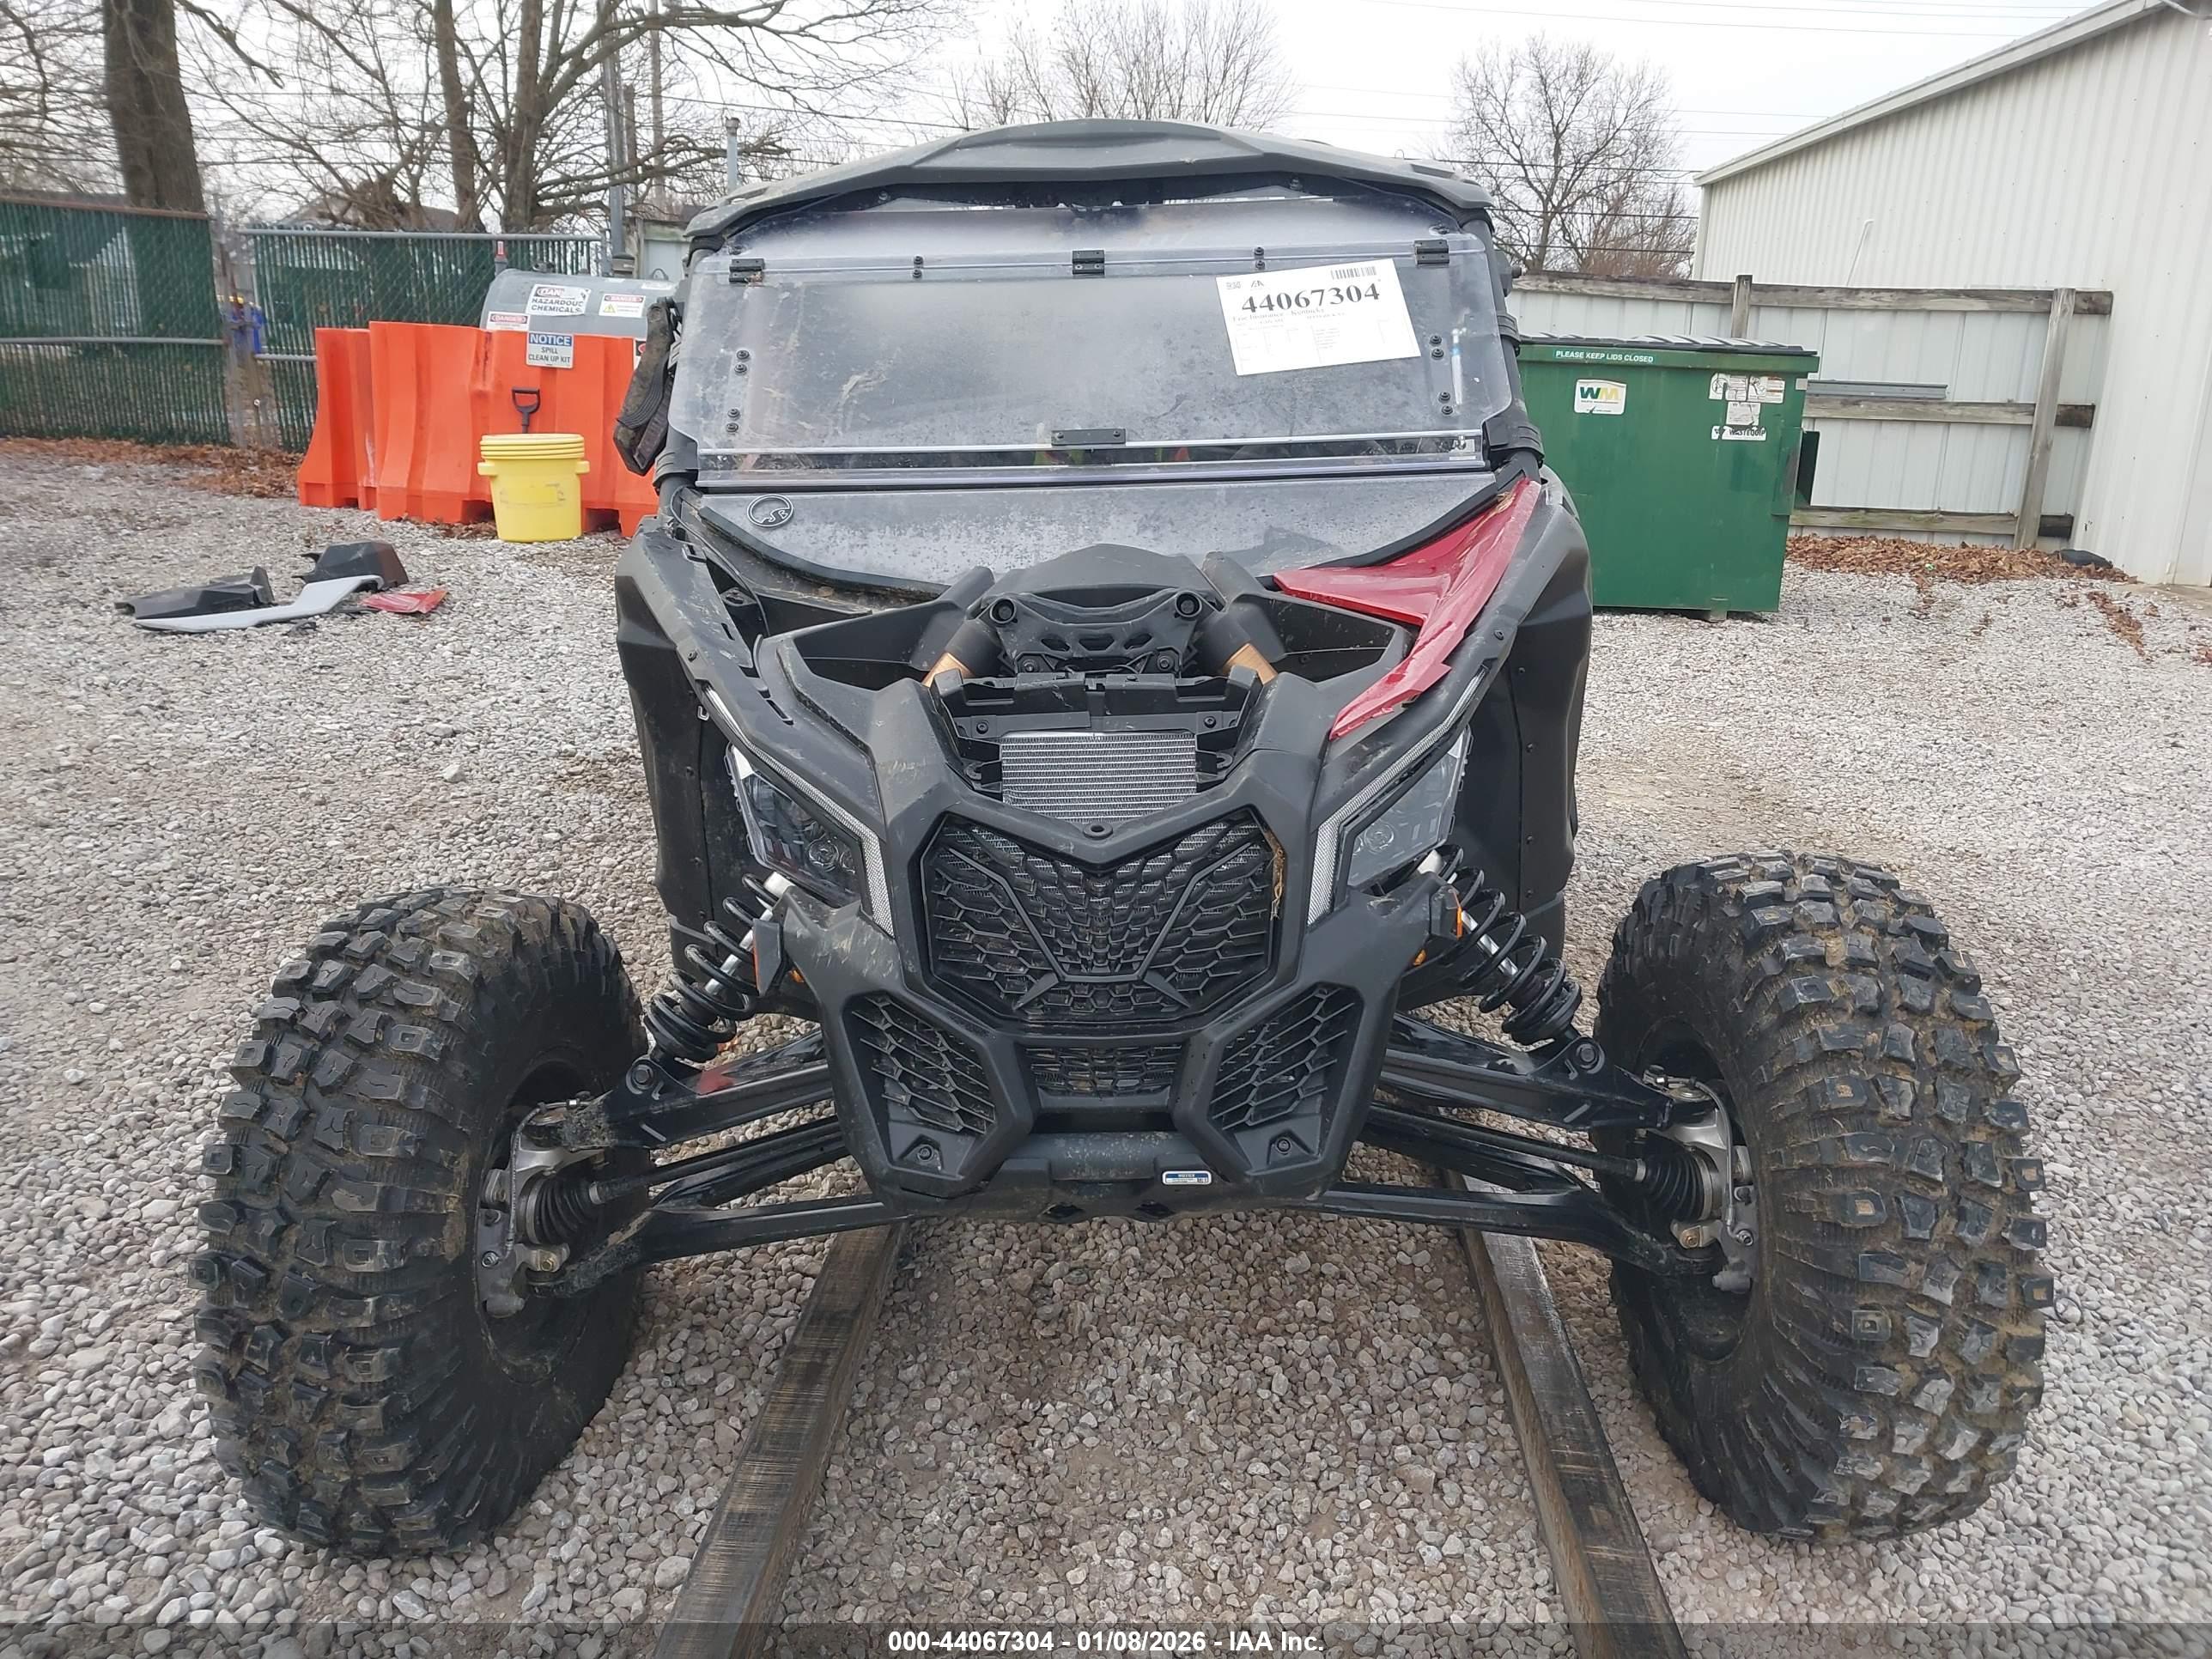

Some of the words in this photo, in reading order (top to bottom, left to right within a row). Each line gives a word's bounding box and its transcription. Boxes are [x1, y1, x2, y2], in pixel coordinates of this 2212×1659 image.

[1242, 283, 1380, 313] 44067304
[530, 333, 571, 346] NOTICE
[1580, 386, 1620, 400] WM
